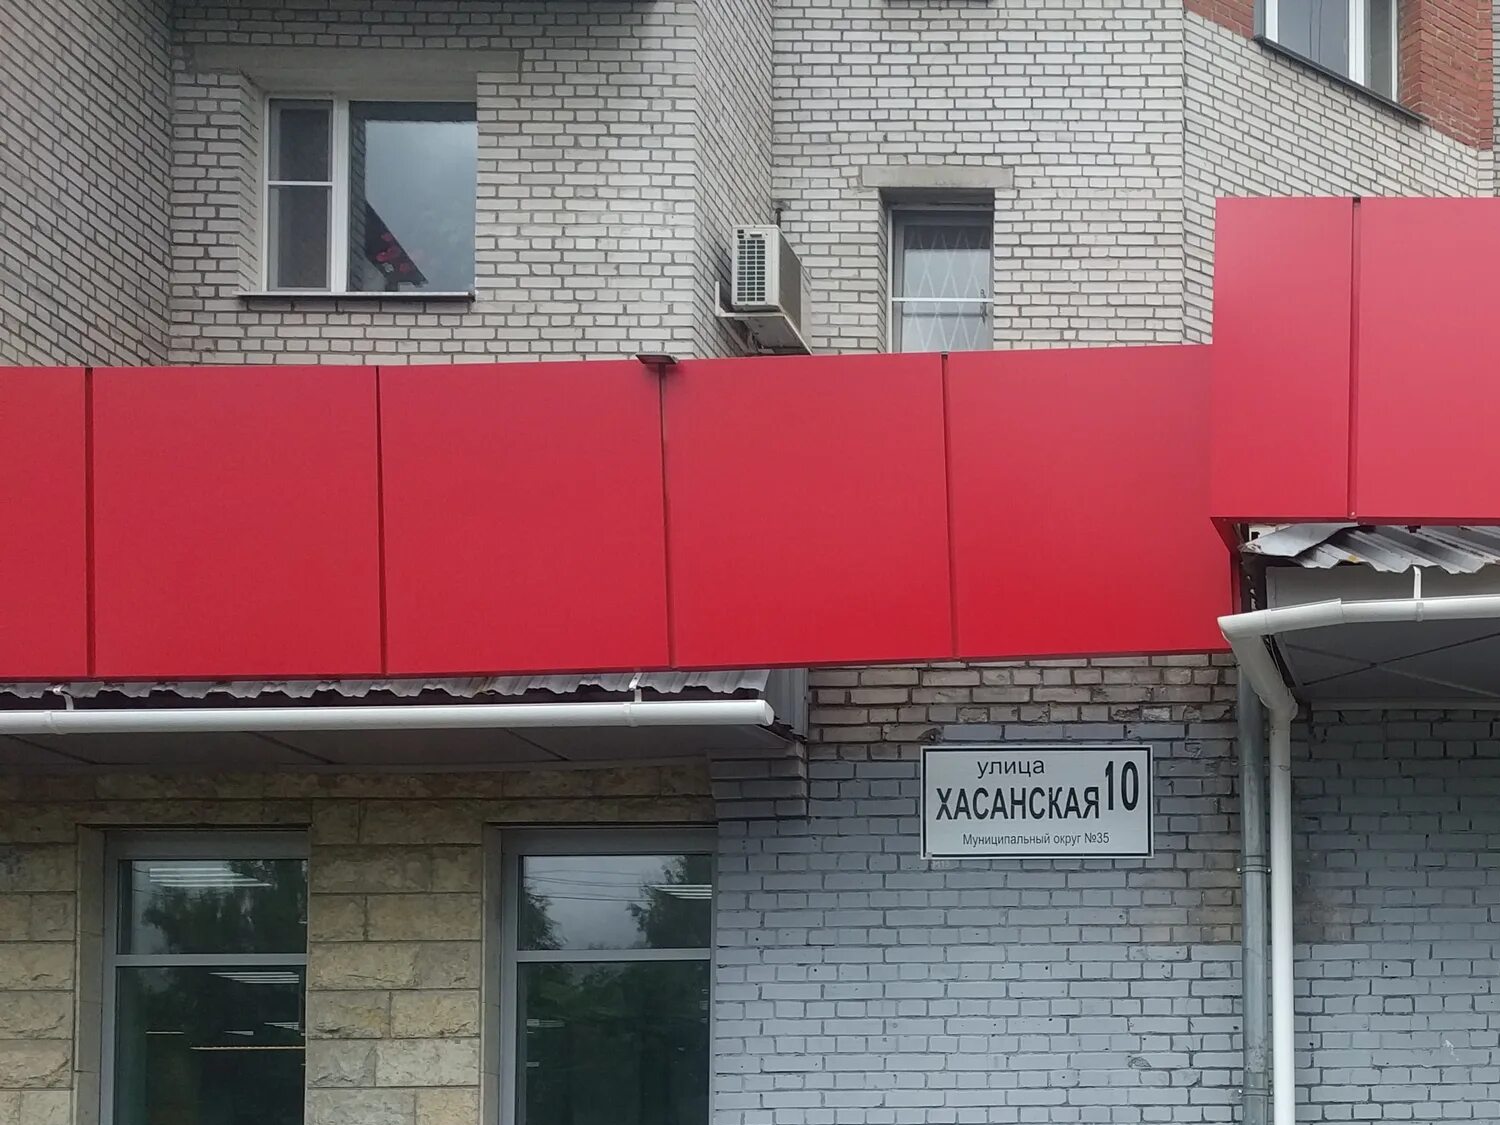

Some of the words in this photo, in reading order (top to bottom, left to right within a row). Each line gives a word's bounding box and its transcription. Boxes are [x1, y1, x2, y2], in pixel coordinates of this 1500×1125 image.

[976, 759, 1045, 779] улица
[935, 786, 1100, 820] ХАСАНСКАЯ
[1104, 760, 1139, 811] 10
[962, 832, 1051, 846] Муниципальный
[1053, 834, 1082, 846] округ
[1084, 832, 1110, 844] №35
